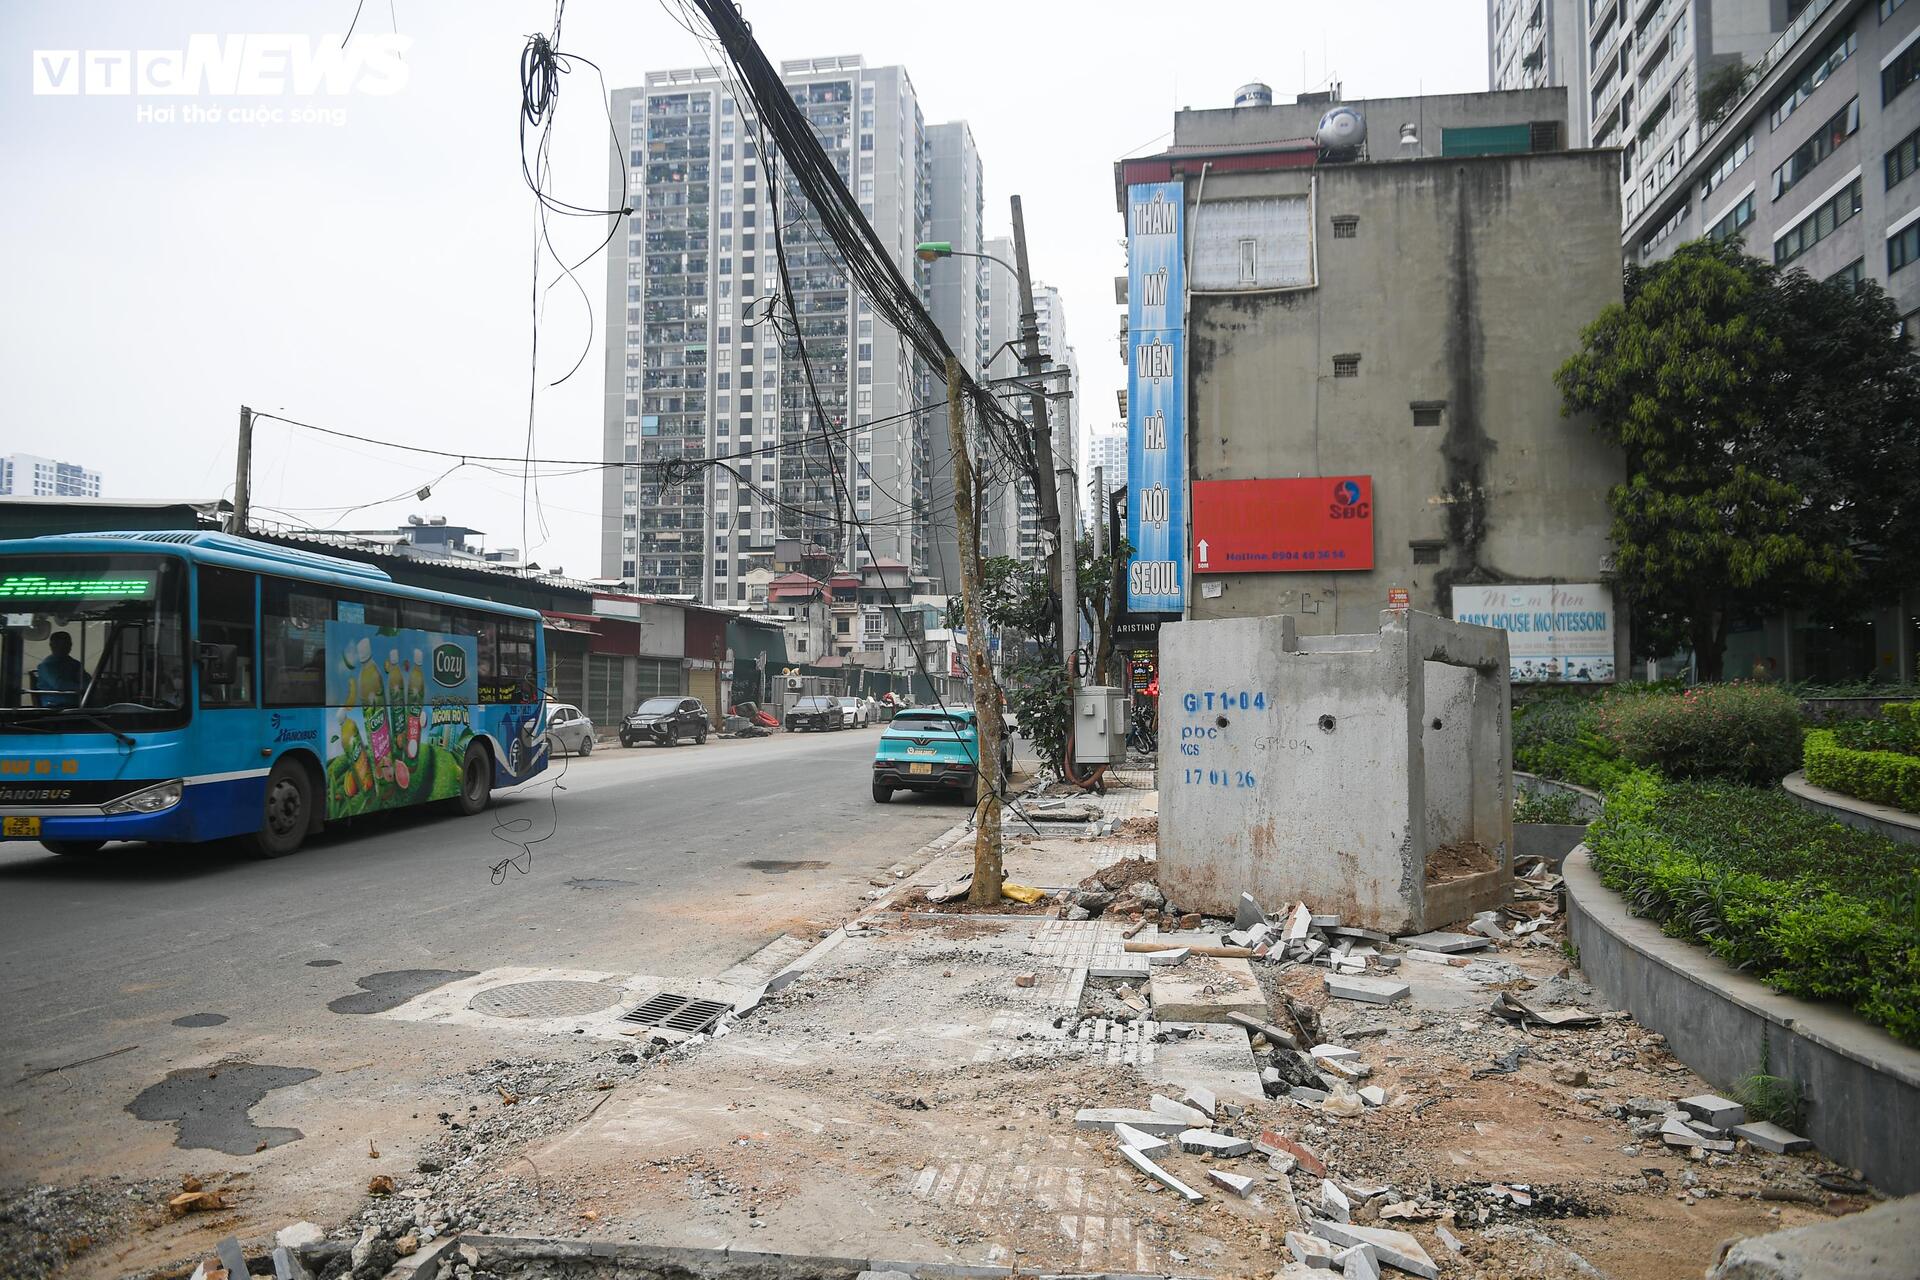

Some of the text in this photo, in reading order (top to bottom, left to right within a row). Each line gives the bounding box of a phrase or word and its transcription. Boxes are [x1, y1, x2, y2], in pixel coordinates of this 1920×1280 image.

[1136, 338, 1173, 385] VIỆN
[1144, 408, 1167, 450] HÀ
[1140, 487, 1169, 530] NỘI
[1129, 560, 1180, 596] SEOUL
[1117, 622, 1156, 633] ARISTINO
[1492, 612, 1531, 632] HOUSE
[1534, 611, 1606, 632] MONTESSORI
[436, 650, 463, 679] Cozy
[1180, 743, 1200, 756] KCS
[1185, 768, 1255, 788] 17 01 26
